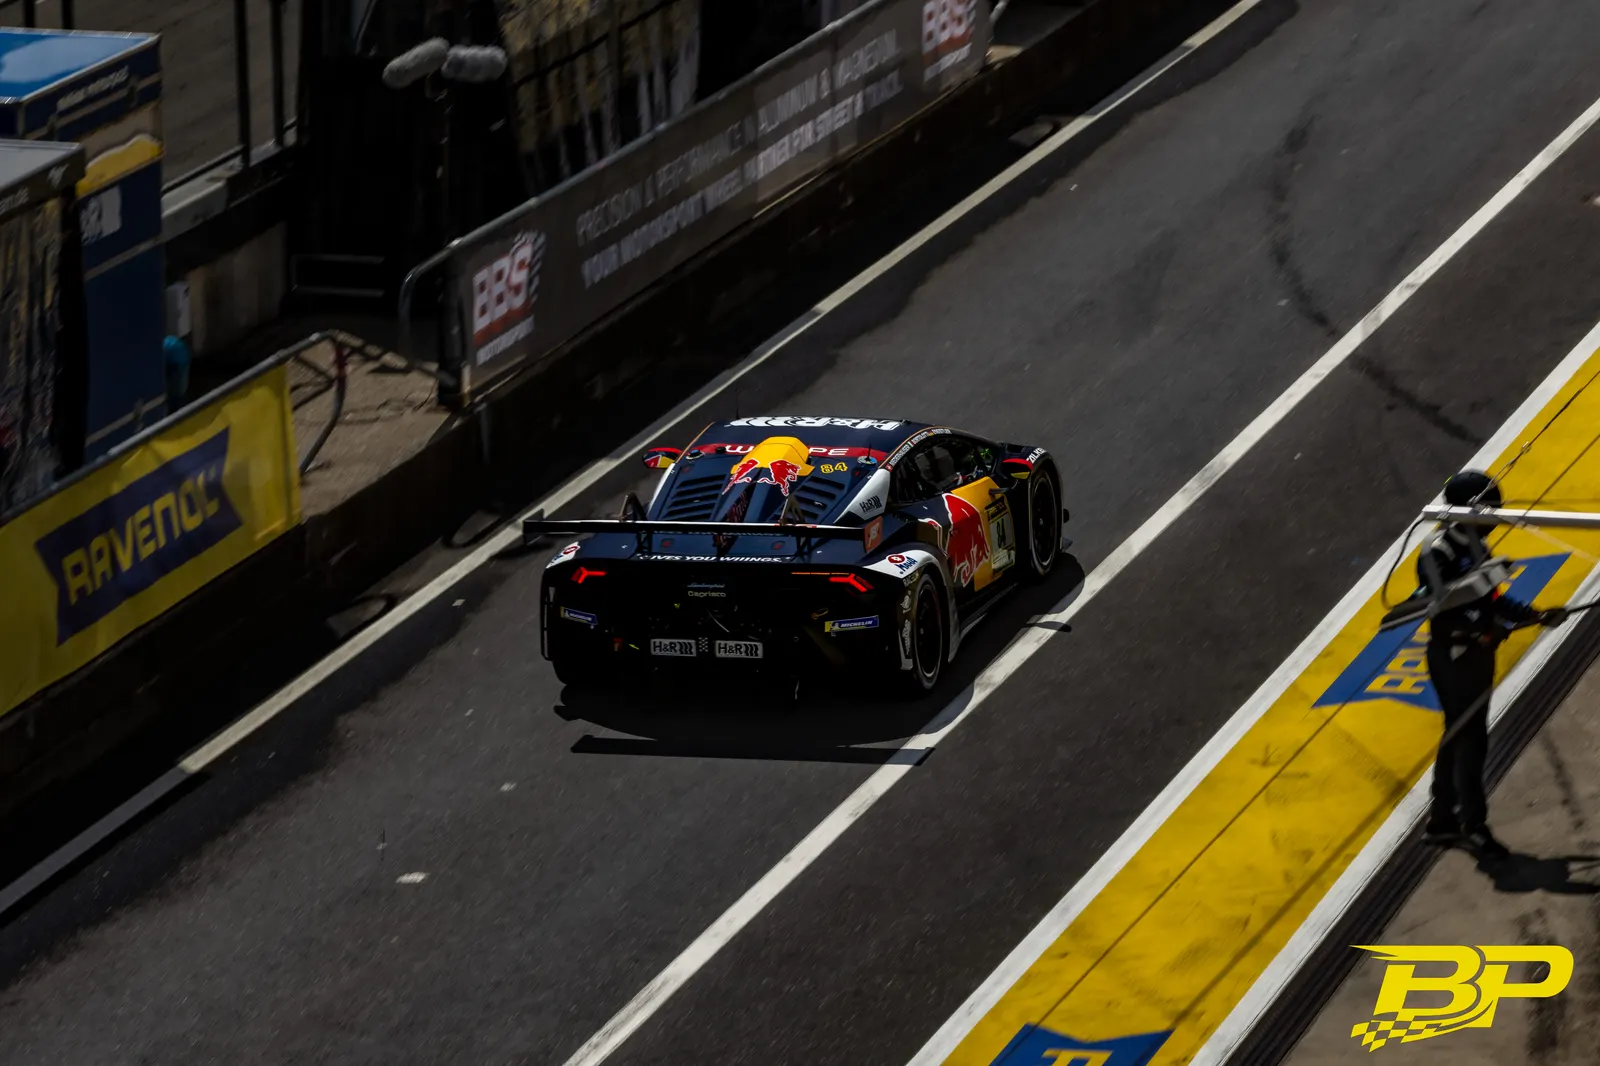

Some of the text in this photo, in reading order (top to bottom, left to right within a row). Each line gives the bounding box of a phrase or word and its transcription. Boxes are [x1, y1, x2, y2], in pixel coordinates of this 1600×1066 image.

[473, 242, 532, 336] BBS
[820, 462, 848, 474] 84
[62, 472, 220, 607] RAVENOL
